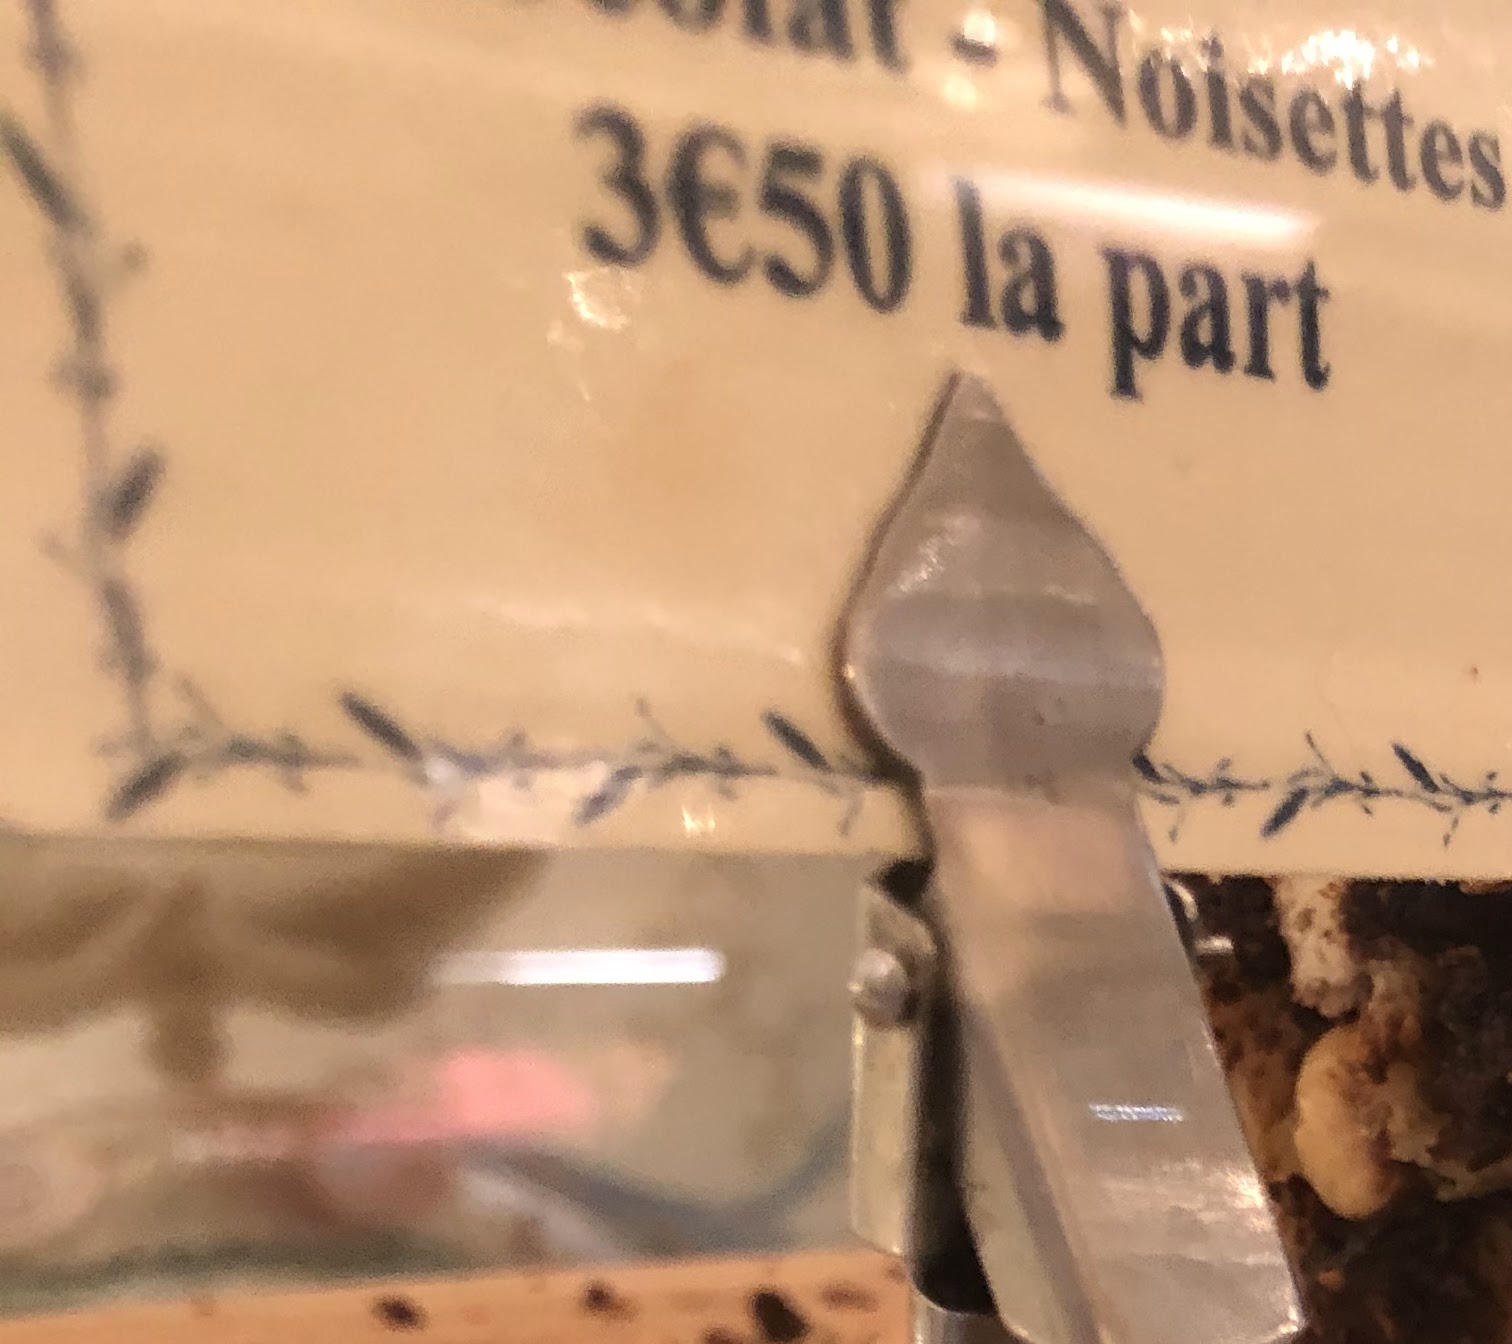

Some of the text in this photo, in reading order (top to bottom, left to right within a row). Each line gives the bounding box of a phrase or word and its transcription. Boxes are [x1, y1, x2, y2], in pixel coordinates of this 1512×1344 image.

[1038, 0, 1507, 210] Noisettes
[574, 103, 1331, 399] 3€50 la part
